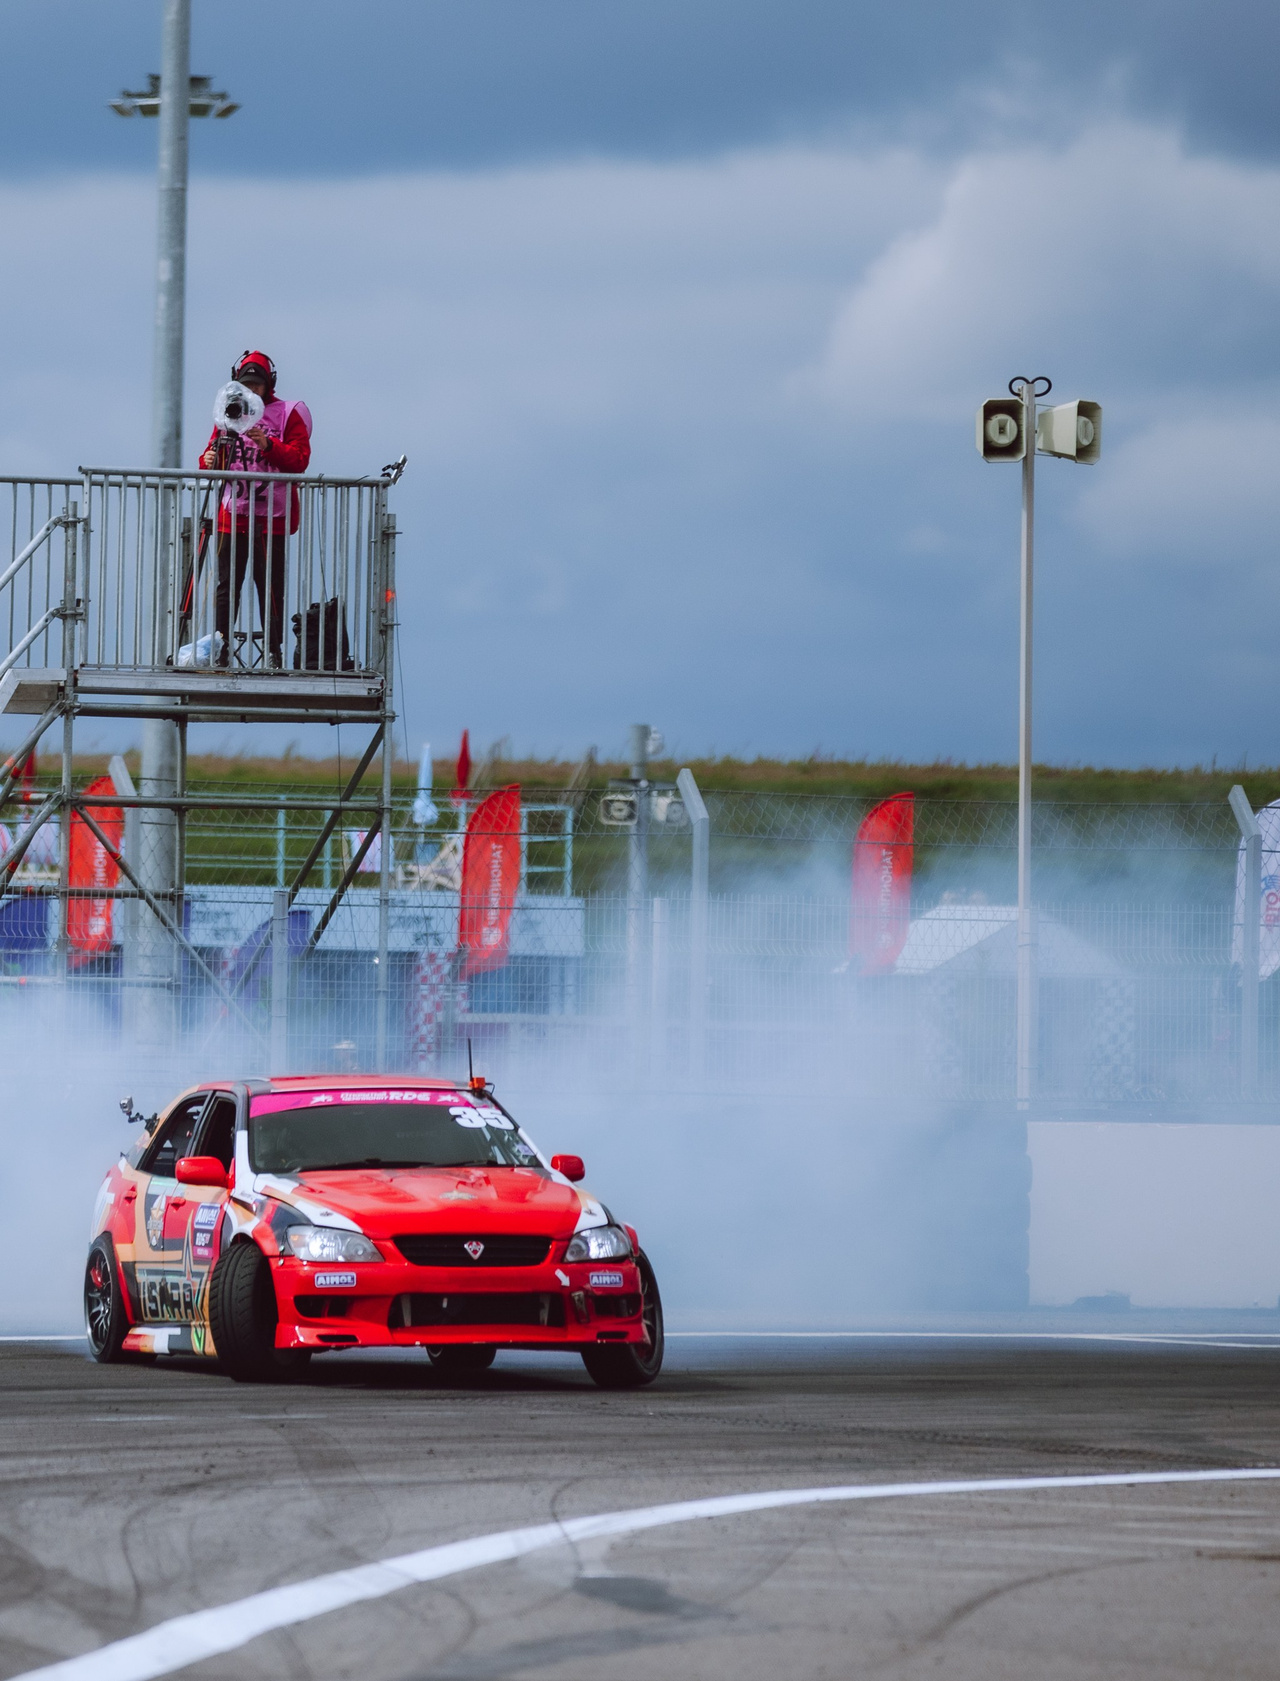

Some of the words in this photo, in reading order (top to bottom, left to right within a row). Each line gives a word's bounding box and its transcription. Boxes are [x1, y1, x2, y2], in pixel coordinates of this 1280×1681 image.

[388, 1091, 431, 1101] RDS
[449, 1106, 515, 1130] 35
[317, 1275, 354, 1285] AIMOL
[592, 1275, 622, 1284] AIMOL
